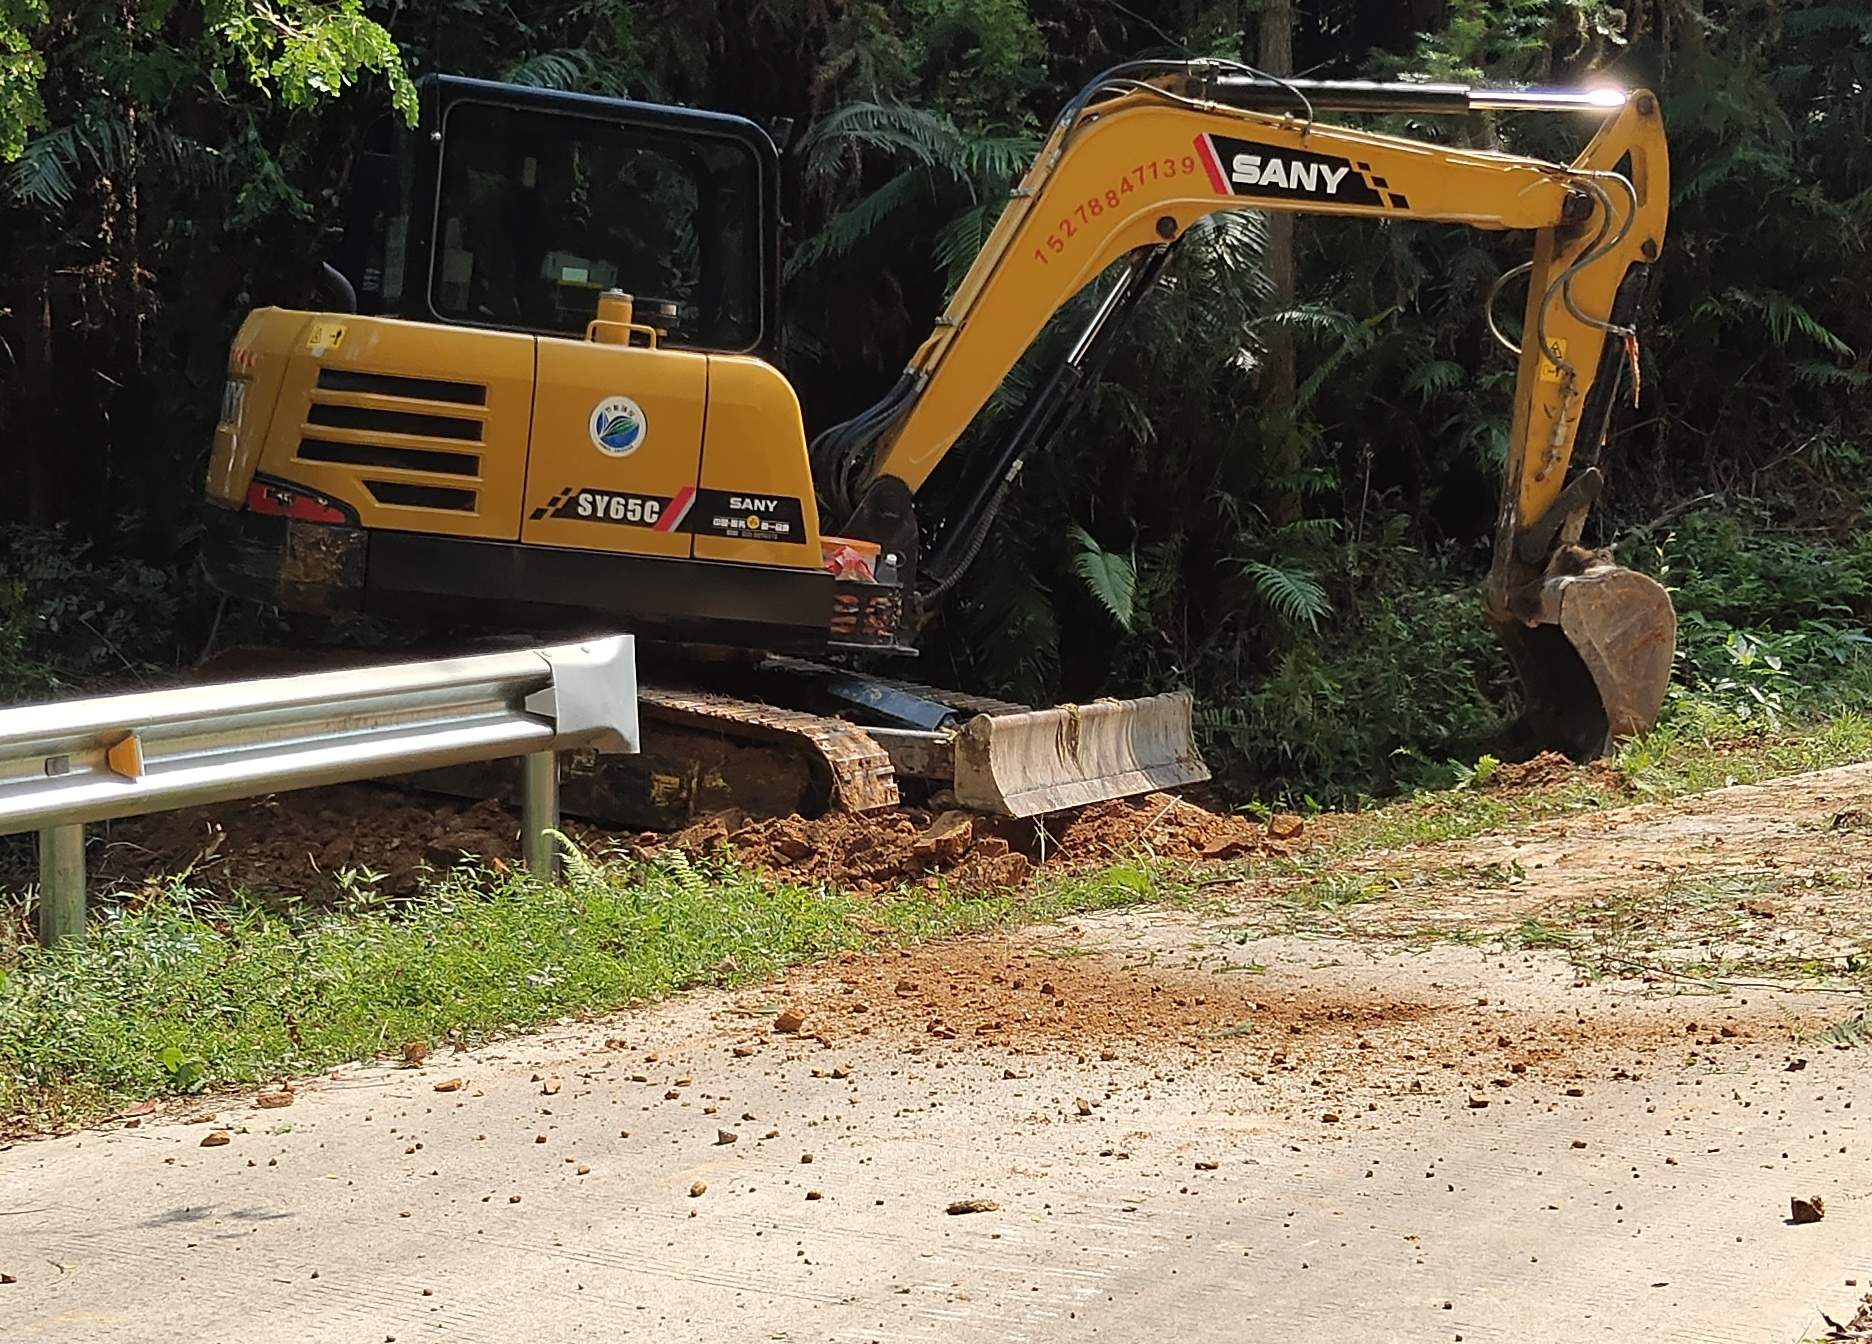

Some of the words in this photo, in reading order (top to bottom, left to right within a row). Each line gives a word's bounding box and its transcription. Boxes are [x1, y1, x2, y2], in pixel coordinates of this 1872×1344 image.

[1231, 154, 1350, 195] SANY
[1034, 155, 1196, 265] 15278847139
[577, 492, 660, 524] SY65C
[729, 497, 778, 512] SANY
